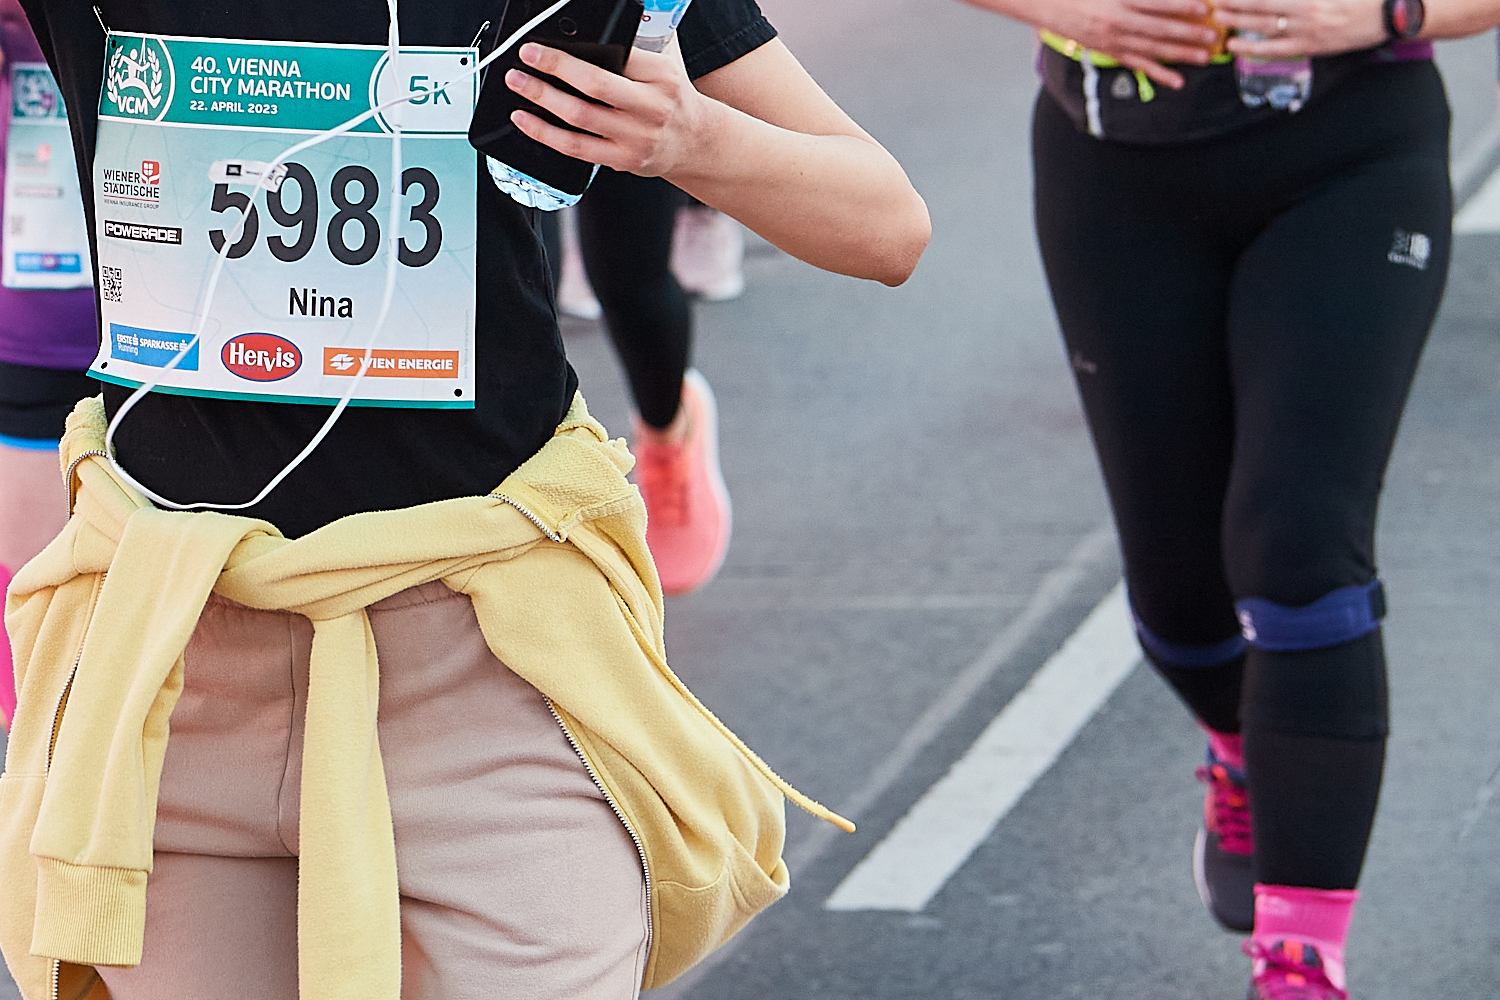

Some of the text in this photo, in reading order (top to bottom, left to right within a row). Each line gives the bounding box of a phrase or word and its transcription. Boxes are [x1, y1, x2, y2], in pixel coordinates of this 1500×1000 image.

[190, 56, 301, 78] 40. VIENNA
[190, 76, 350, 101] CITY MARATHON
[117, 95, 149, 116] VCM
[190, 100, 278, 115] 22. APRIL 2023
[103, 169, 140, 184] WIENER
[103, 181, 160, 199] STÄDTISCHE
[208, 162, 443, 268] 5983
[289, 287, 353, 318] Nina
[229, 342, 296, 372] Hervis
[359, 357, 453, 371] WIEN ENERGIE
